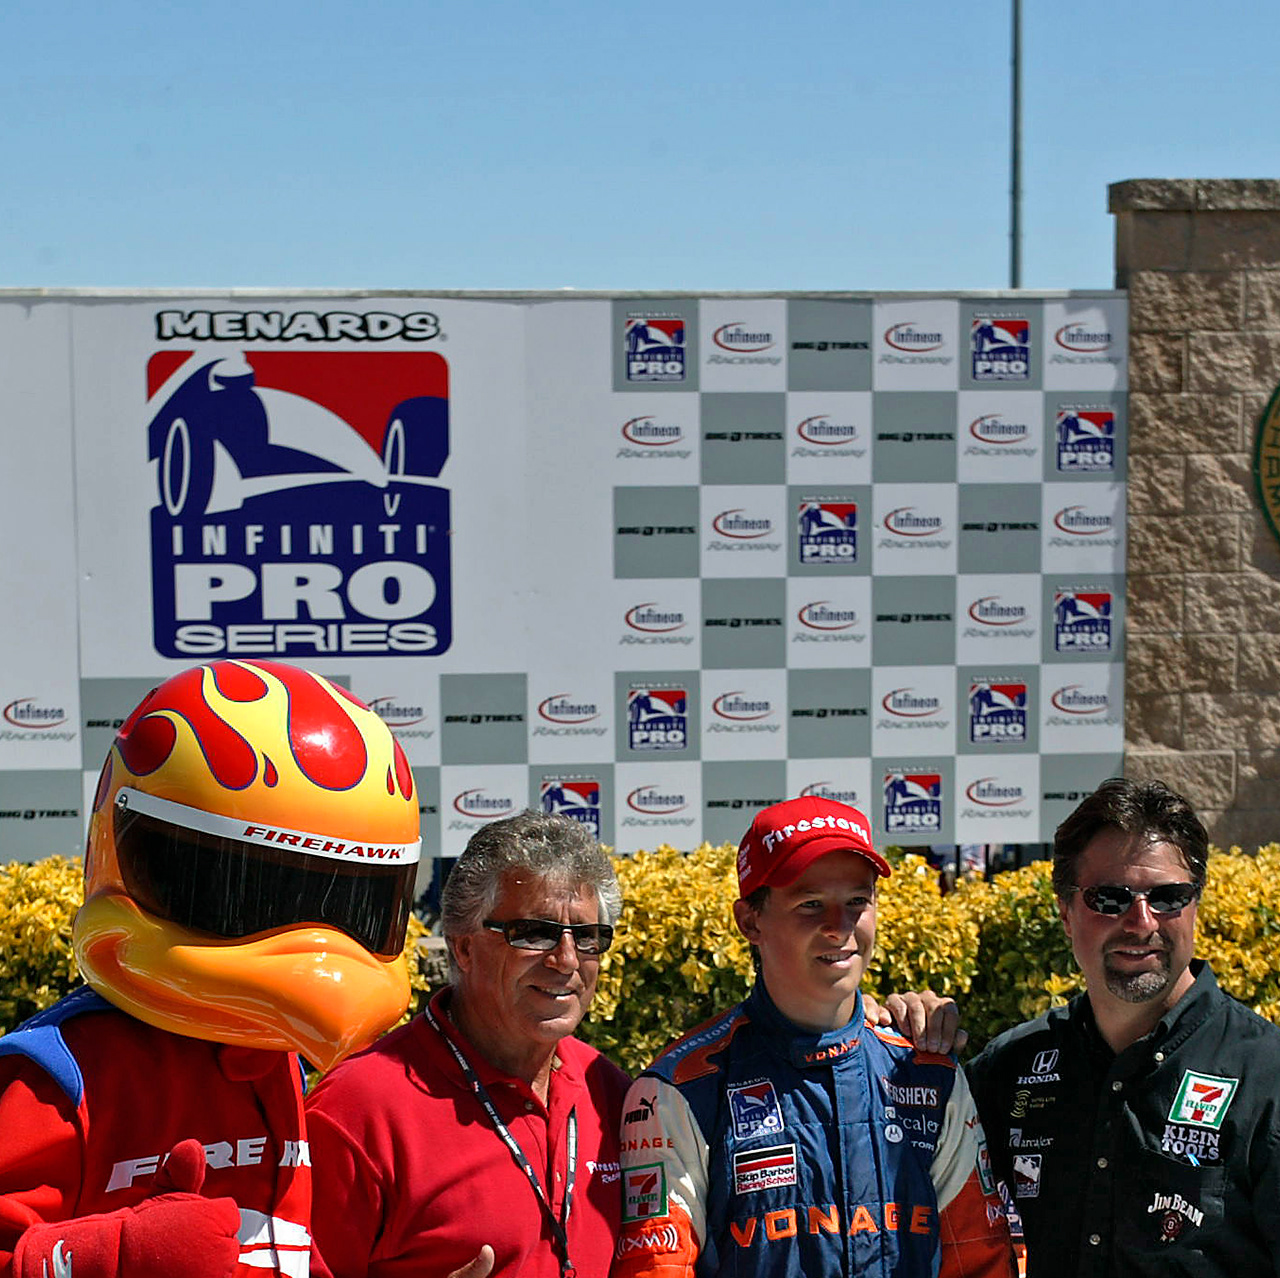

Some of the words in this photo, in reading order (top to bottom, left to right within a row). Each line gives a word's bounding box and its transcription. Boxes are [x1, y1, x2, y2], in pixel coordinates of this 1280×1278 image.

[156, 311, 440, 342] MENARDS
[629, 361, 684, 375] PRO
[974, 360, 1028, 374] PRO
[917, 432, 954, 442] TIRES
[1060, 452, 1112, 465] PRO
[172, 525, 428, 555] INFINITI
[803, 544, 855, 557] PRO
[174, 561, 436, 621] PRO
[174, 623, 438, 654] SERIES
[1058, 633, 1110, 646] PRO
[632, 730, 686, 744] PRO
[973, 724, 1025, 737] PRO
[39, 810, 78, 820] TIRES
[888, 814, 940, 827] PRO
[241, 825, 404, 860] FIREHAWK
[1016, 1072, 1061, 1085] HONDA
[737, 1115, 779, 1133] PRO
[1163, 1124, 1220, 1148] KLEIN
[1162, 1138, 1220, 1160] TOOLS
[105, 1136, 267, 1194] FRE
[736, 1172, 758, 1183] Skip
[760, 1166, 795, 1179] Barber
[766, 1174, 796, 1186] School
[1170, 1193, 1205, 1227] BEAM
[730, 1202, 934, 1249] VONAGE
